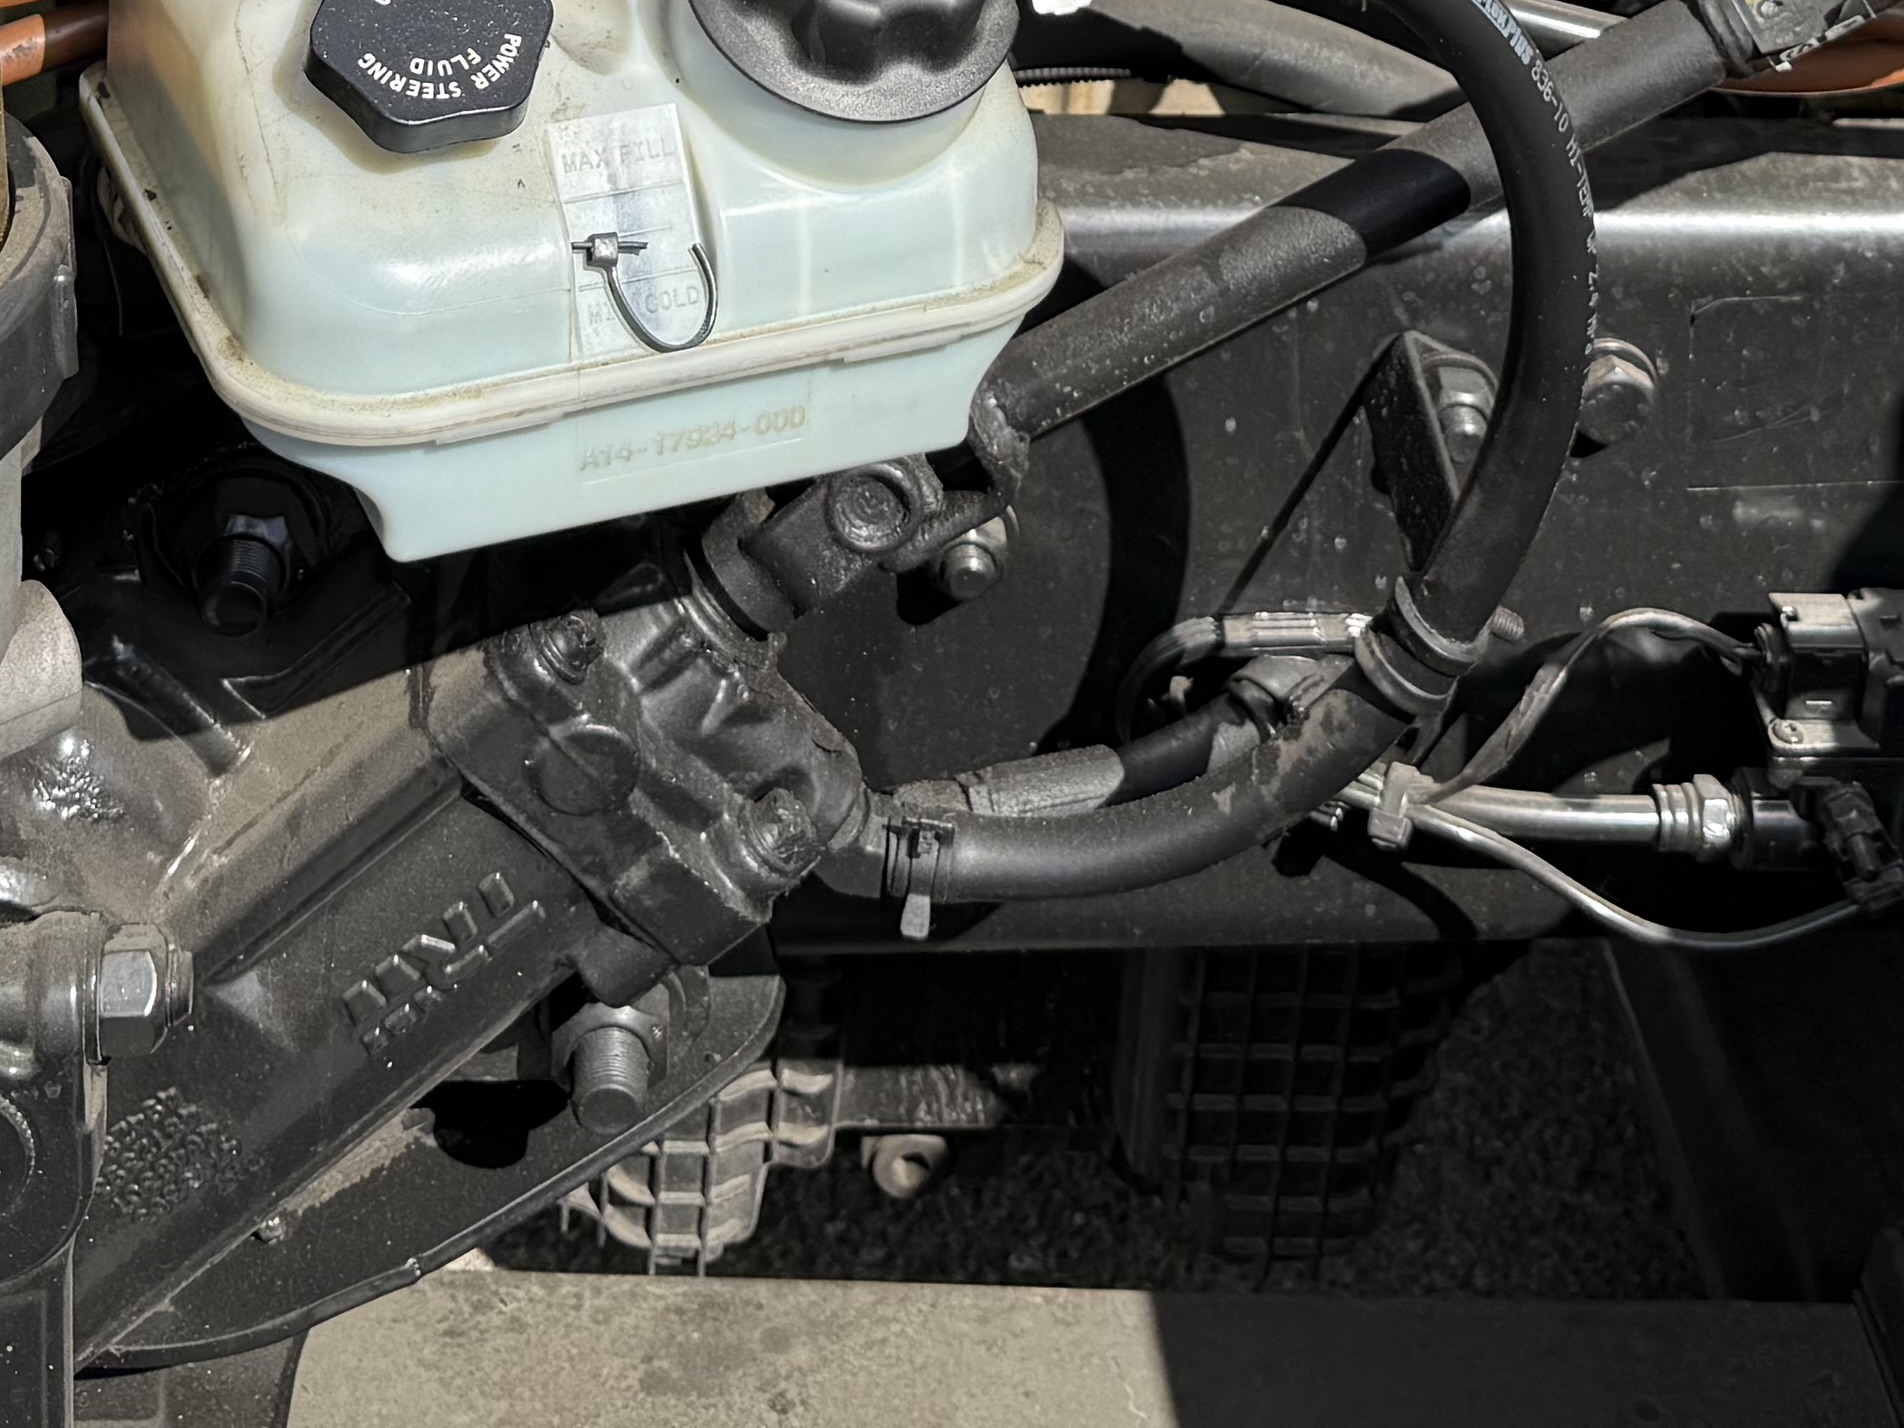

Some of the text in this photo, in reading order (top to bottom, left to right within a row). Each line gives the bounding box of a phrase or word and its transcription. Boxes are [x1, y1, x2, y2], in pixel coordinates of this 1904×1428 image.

[356, 32, 524, 101] POWER STEERING
[409, 47, 483, 77] FLUID
[1530, 60, 1569, 133] 836-10
[561, 136, 677, 175] MAX FILL
[643, 285, 701, 315] COLD
[342, 871, 546, 1057] TRW
